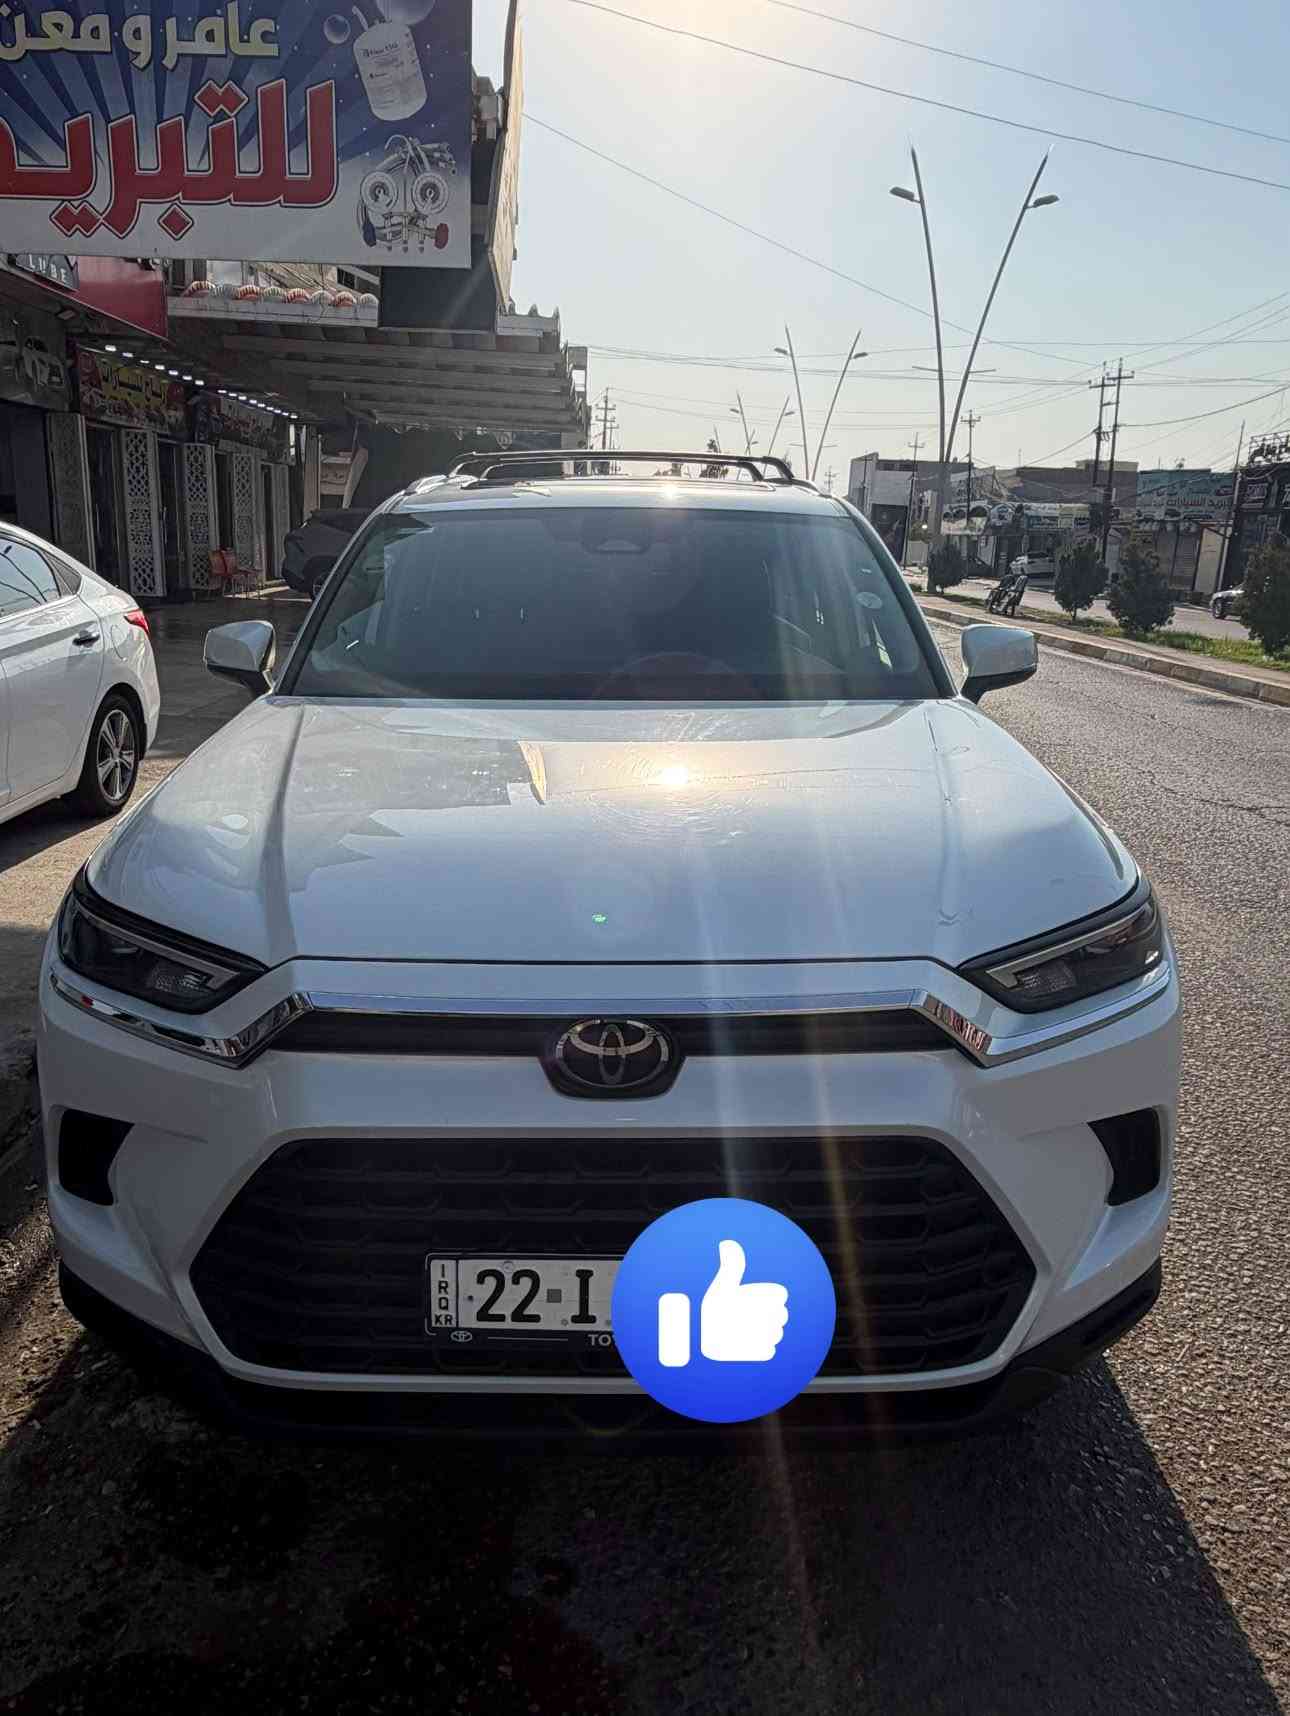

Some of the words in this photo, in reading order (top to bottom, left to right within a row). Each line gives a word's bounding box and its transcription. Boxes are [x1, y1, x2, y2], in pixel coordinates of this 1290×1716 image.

[122, 14, 152, 69] و
[162, 0, 280, 71] عامر
[433, 1313, 454, 1327] KR
[475, 1268, 542, 1324] 22
